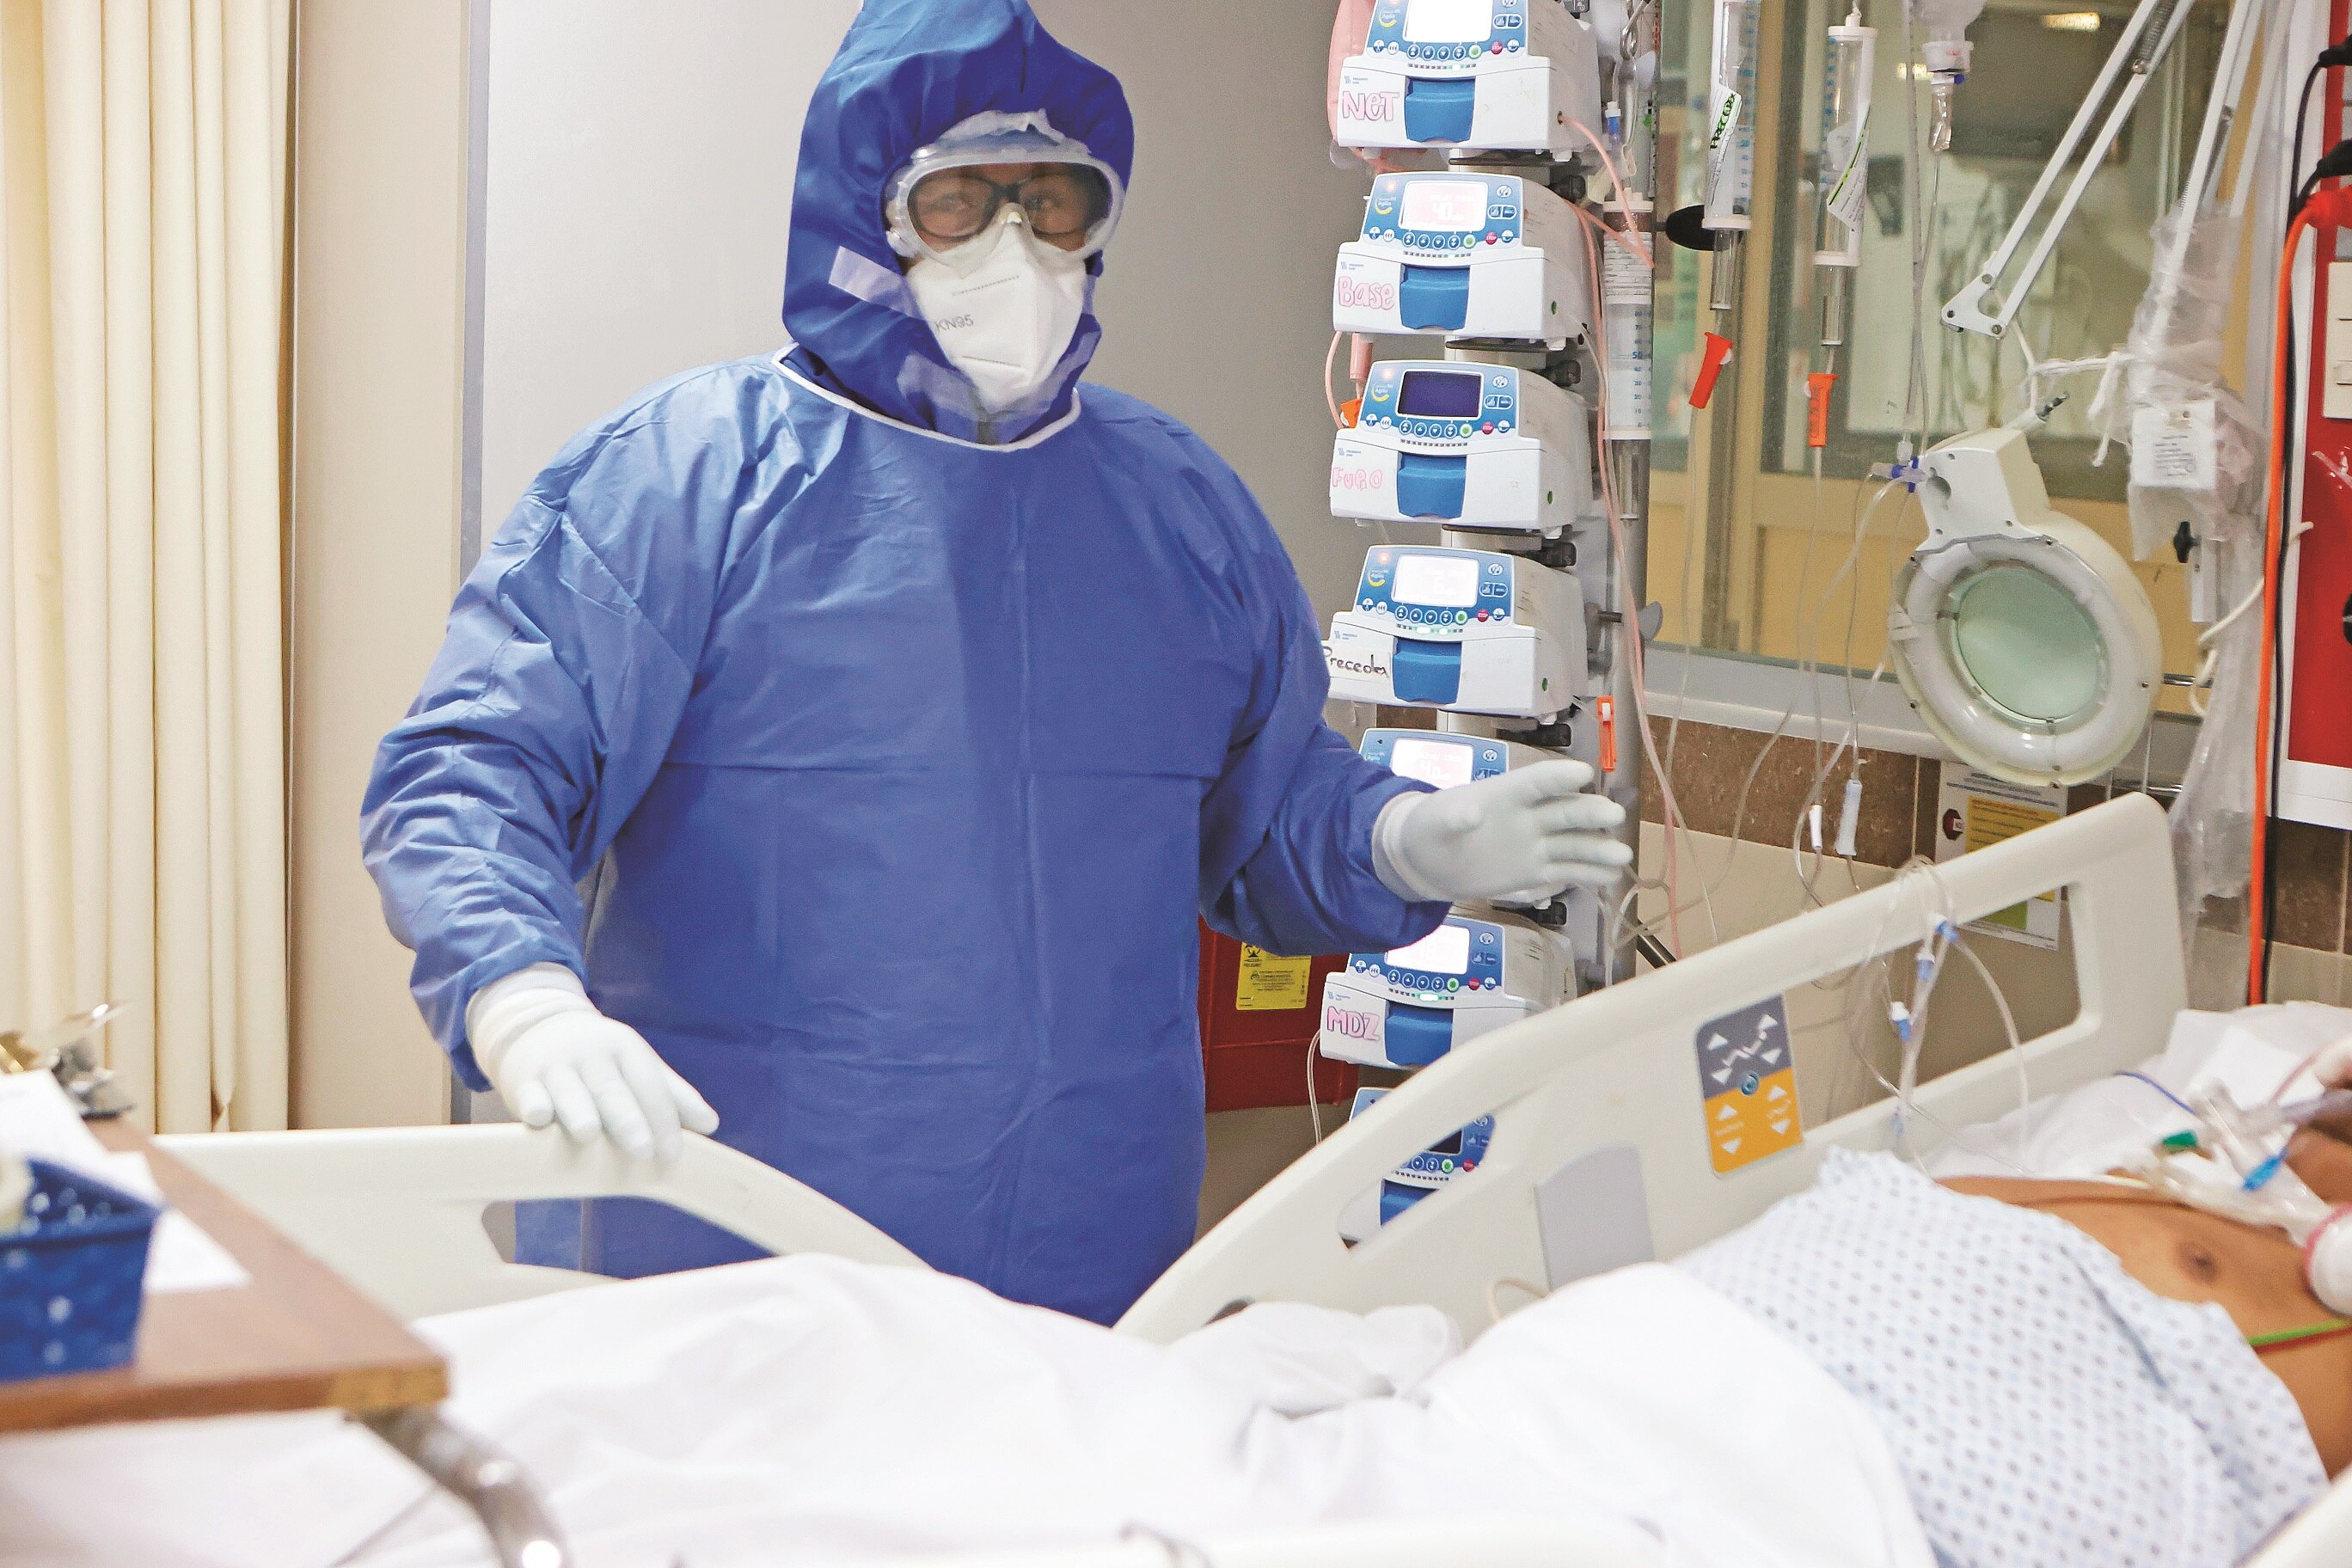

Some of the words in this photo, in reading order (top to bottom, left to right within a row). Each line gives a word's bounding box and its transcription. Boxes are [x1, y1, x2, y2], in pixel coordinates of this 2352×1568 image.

[1338, 275, 1395, 310] Base
[934, 314, 974, 333] KN95
[1326, 1005, 1381, 1041] MDZ
